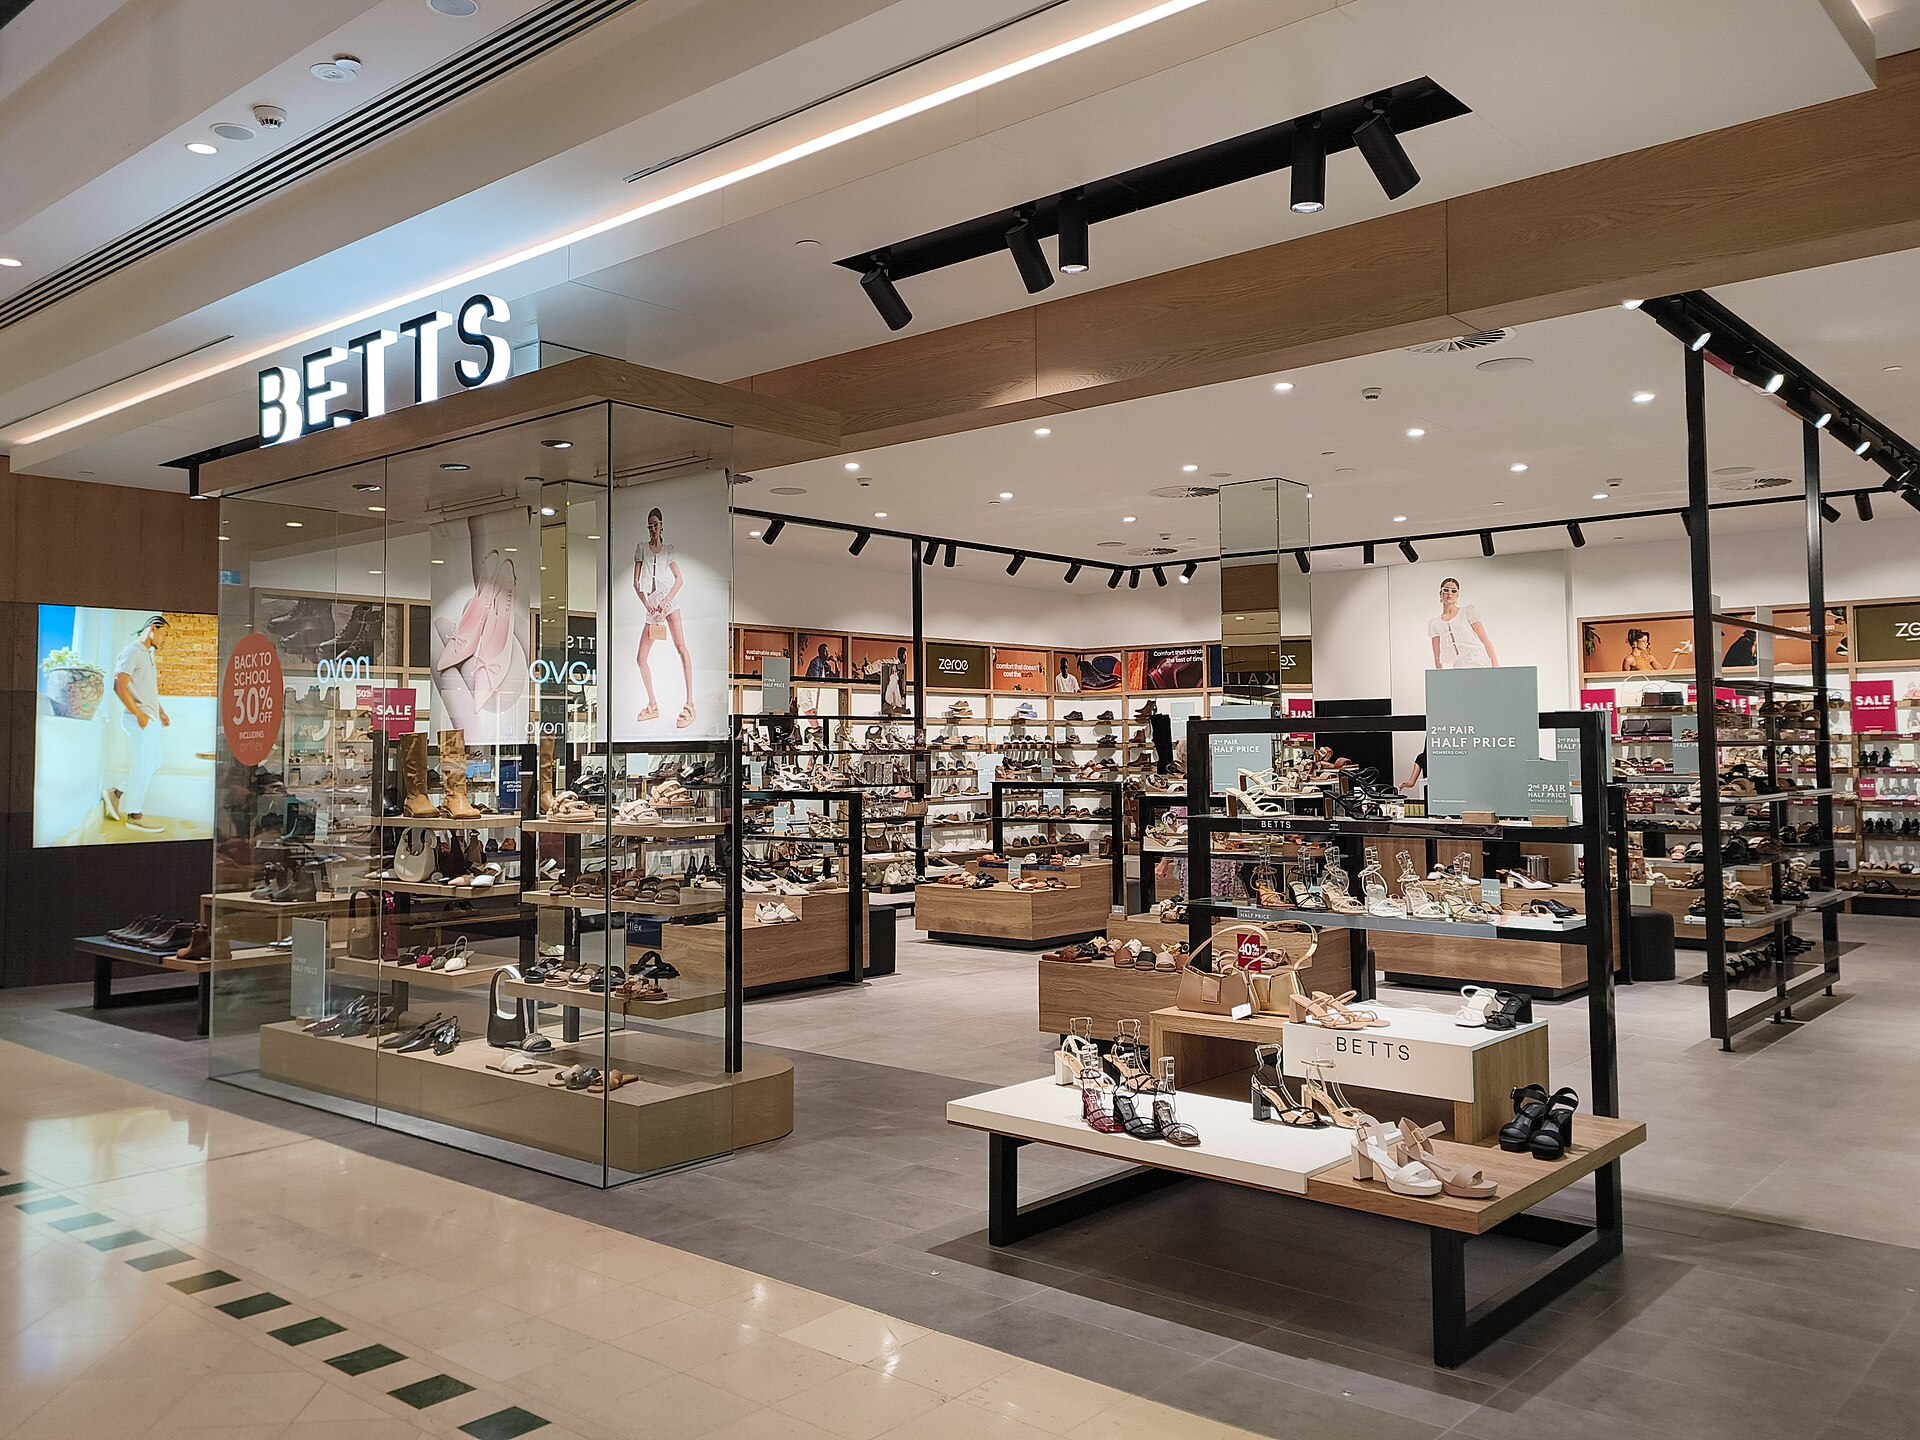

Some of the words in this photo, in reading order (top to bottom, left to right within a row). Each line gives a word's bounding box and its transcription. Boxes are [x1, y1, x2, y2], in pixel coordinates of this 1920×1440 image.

[259, 294, 511, 448] BETTS
[234, 653, 258, 669] BACK
[259, 651, 272, 667] TO
[938, 658, 969, 671] zeroe
[234, 669, 271, 686] SCHOOL
[232, 686, 273, 726] 30%
[1584, 702, 1614, 711] SALE
[1855, 695, 1891, 706] SALE
[376, 704, 412, 716] SALE
[259, 711, 273, 724] OFF
[239, 730, 264, 740] INCLUDING
[1431, 726, 1447, 735] 2nd
[1449, 726, 1476, 735] PAIR
[1431, 737, 1468, 748] HALF
[1473, 737, 1516, 748] PRICE
[1527, 784, 1541, 792] 2nd
[1542, 784, 1567, 792] PAIR
[1261, 820, 1292, 829] BETTS
[1238, 943, 1260, 956] 40%
[1336, 1036, 1410, 1061] BETTS
